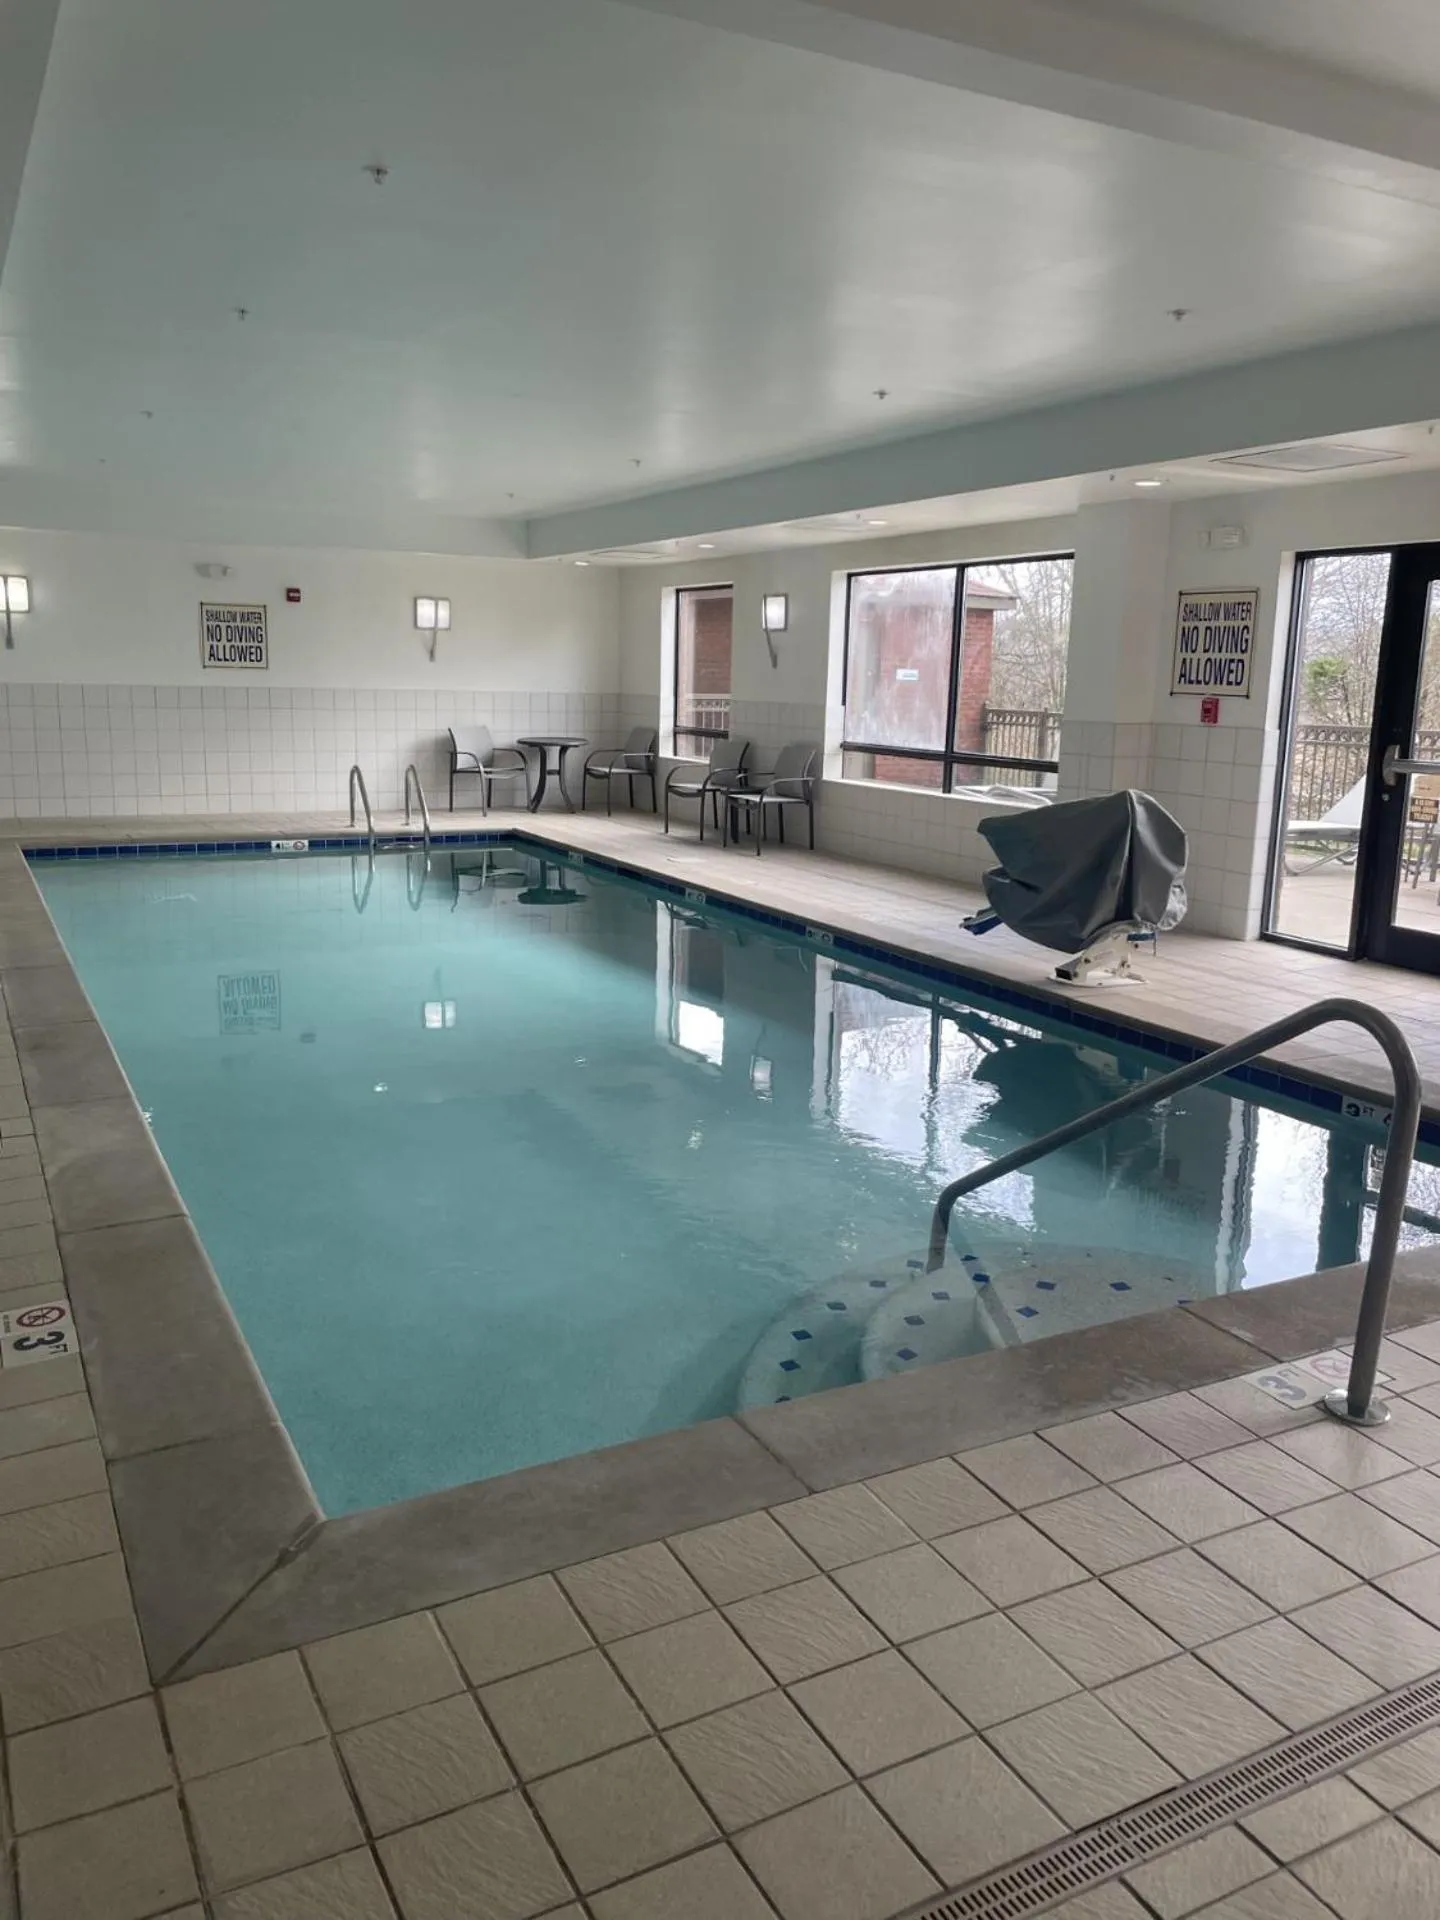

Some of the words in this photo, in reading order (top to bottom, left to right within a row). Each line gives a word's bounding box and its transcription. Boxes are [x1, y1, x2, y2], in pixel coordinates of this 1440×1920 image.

[205, 609, 237, 623] SHALLOW
[239, 611, 263, 624] WATER
[1182, 602, 1222, 622] SHALLOW
[1223, 601, 1252, 621] WATER
[207, 624, 222, 642] NO
[226, 624, 263, 643] DIVING
[1179, 625, 1200, 654] NO
[1202, 625, 1250, 654] DIVING
[208, 644, 263, 662] ALLOWED
[1177, 657, 1245, 686] ALLOWED
[1343, 1103, 1361, 1118] 3
[1362, 1106, 1376, 1119] FT
[13, 1331, 65, 1351] 3
[48, 1343, 69, 1355] FT
[1257, 1375, 1307, 1400] 3
